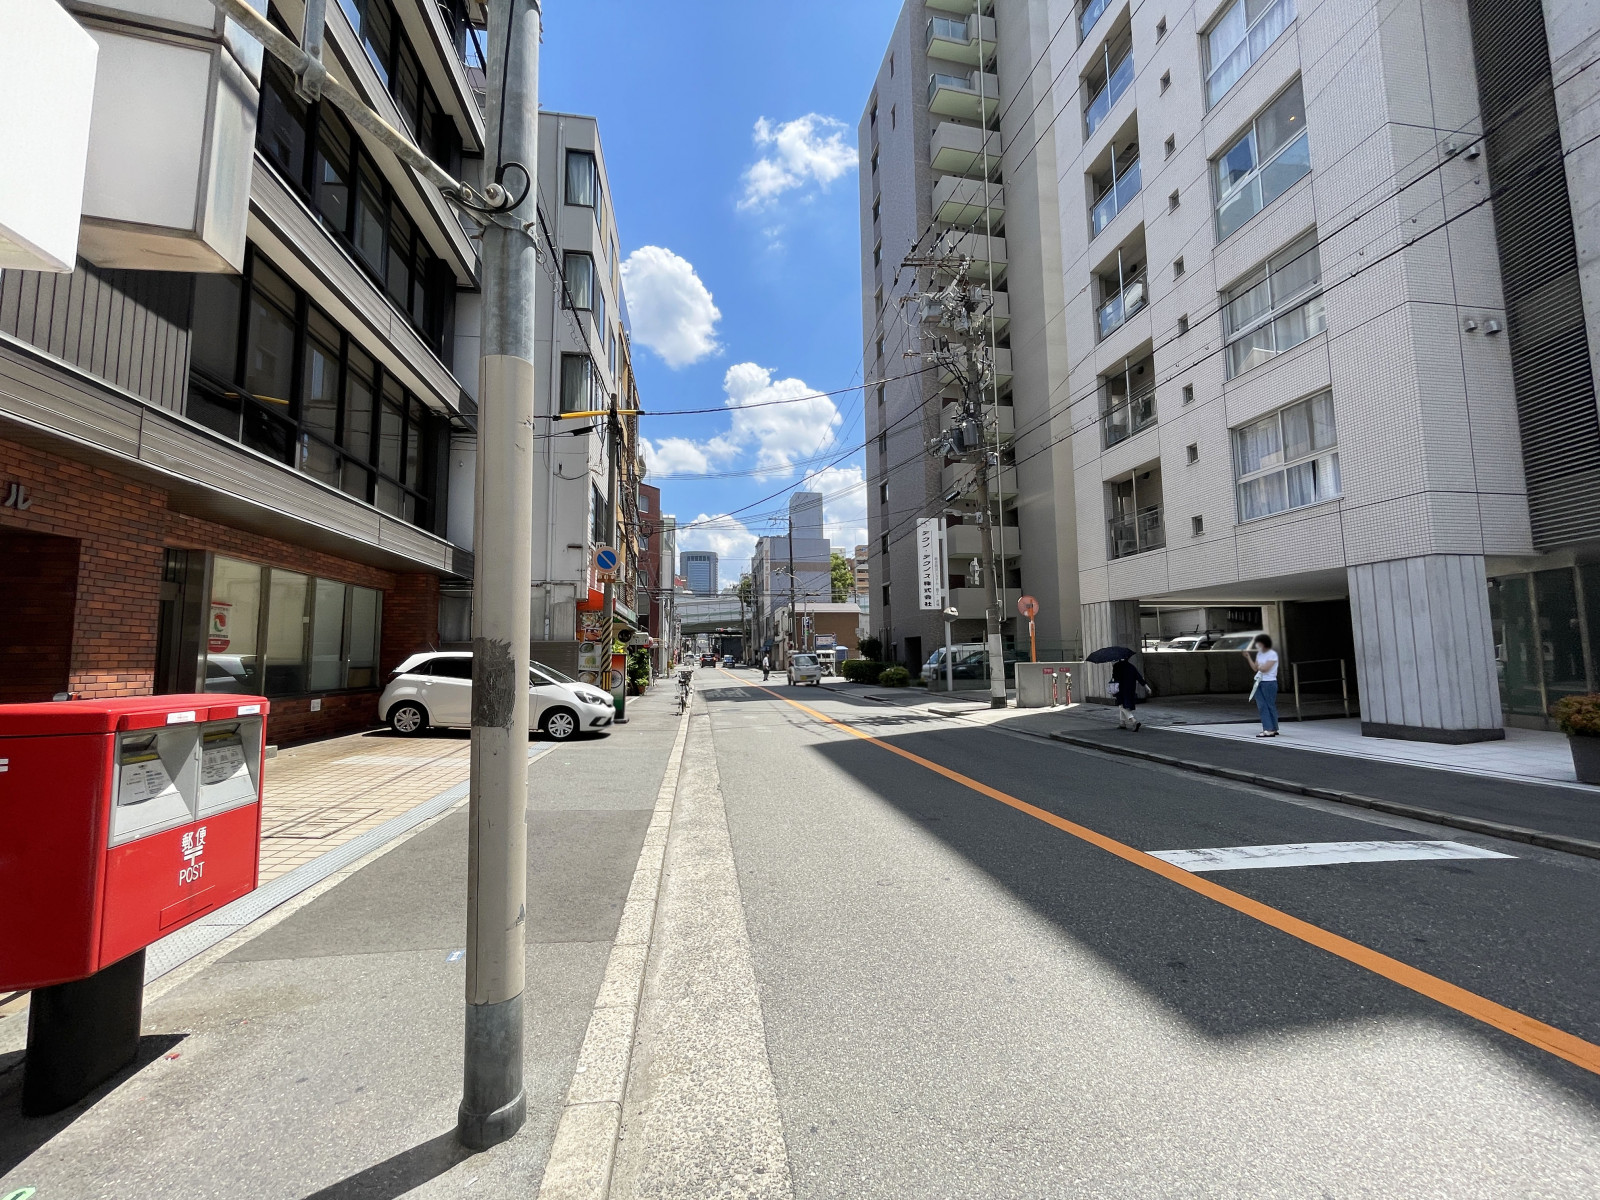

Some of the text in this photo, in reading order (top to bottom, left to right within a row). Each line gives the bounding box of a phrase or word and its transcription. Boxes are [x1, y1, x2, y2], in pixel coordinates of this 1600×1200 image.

[4, 483, 33, 510] ル
[181, 826, 207, 852] 郵便
[178, 861, 205, 887] POST
